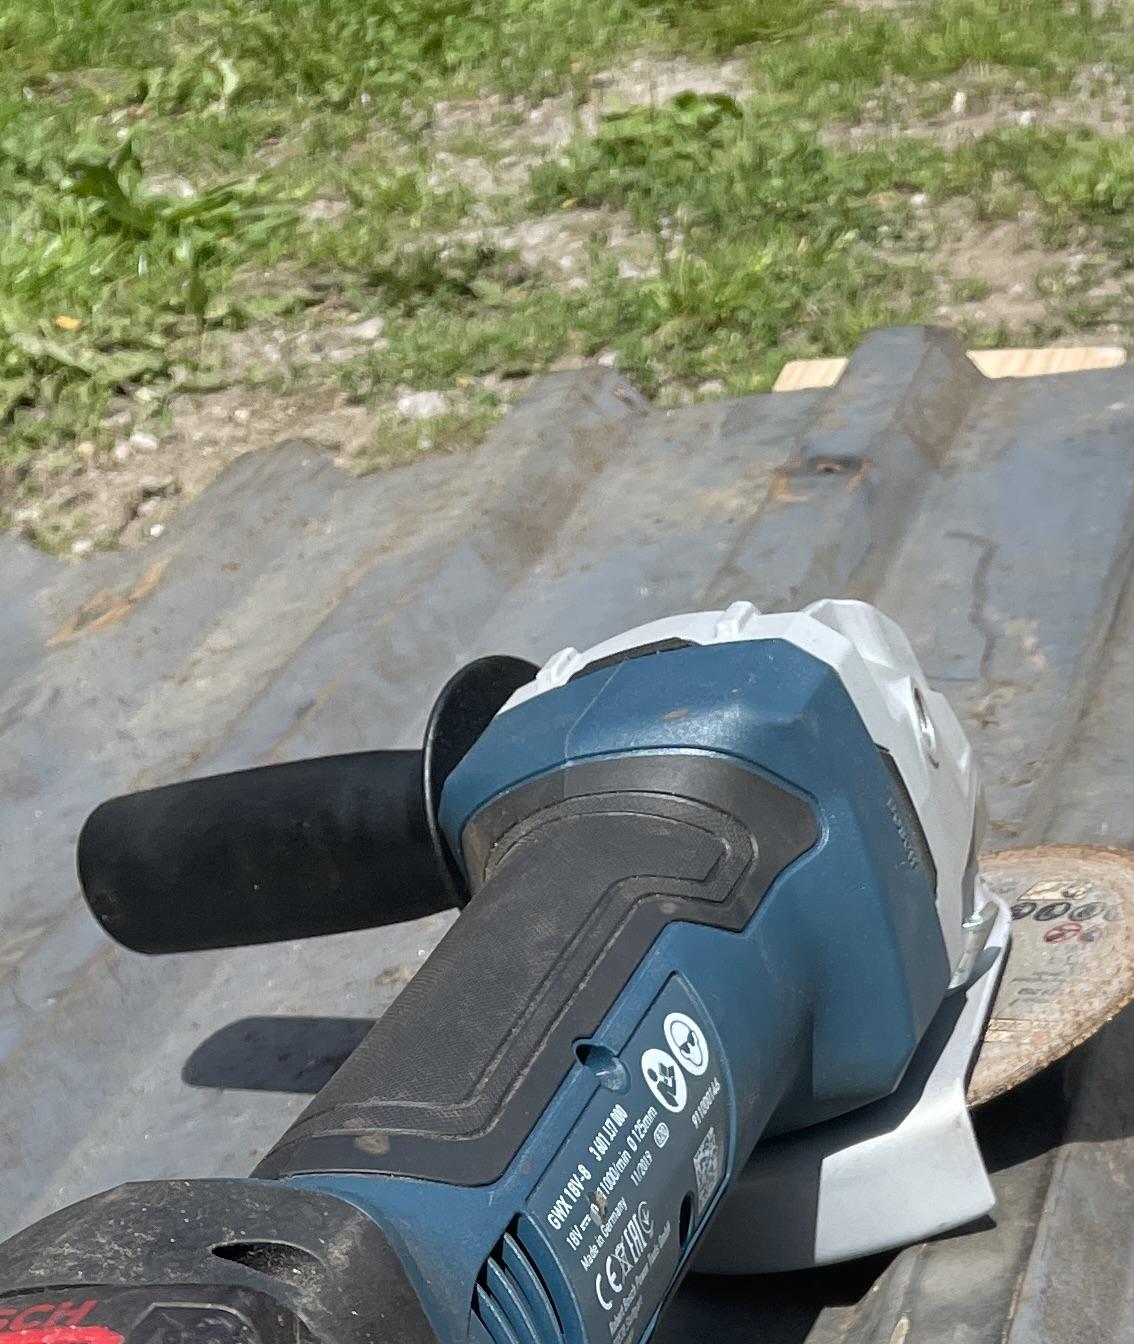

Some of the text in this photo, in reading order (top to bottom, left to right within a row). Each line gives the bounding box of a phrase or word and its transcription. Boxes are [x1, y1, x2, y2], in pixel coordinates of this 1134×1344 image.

[547, 1164, 591, 1230] GWX 18V-8
[566, 1224, 583, 1251] 18V
[631, 1107, 658, 1143] 125mm
[580, 1197, 628, 1271] Made in Germany
